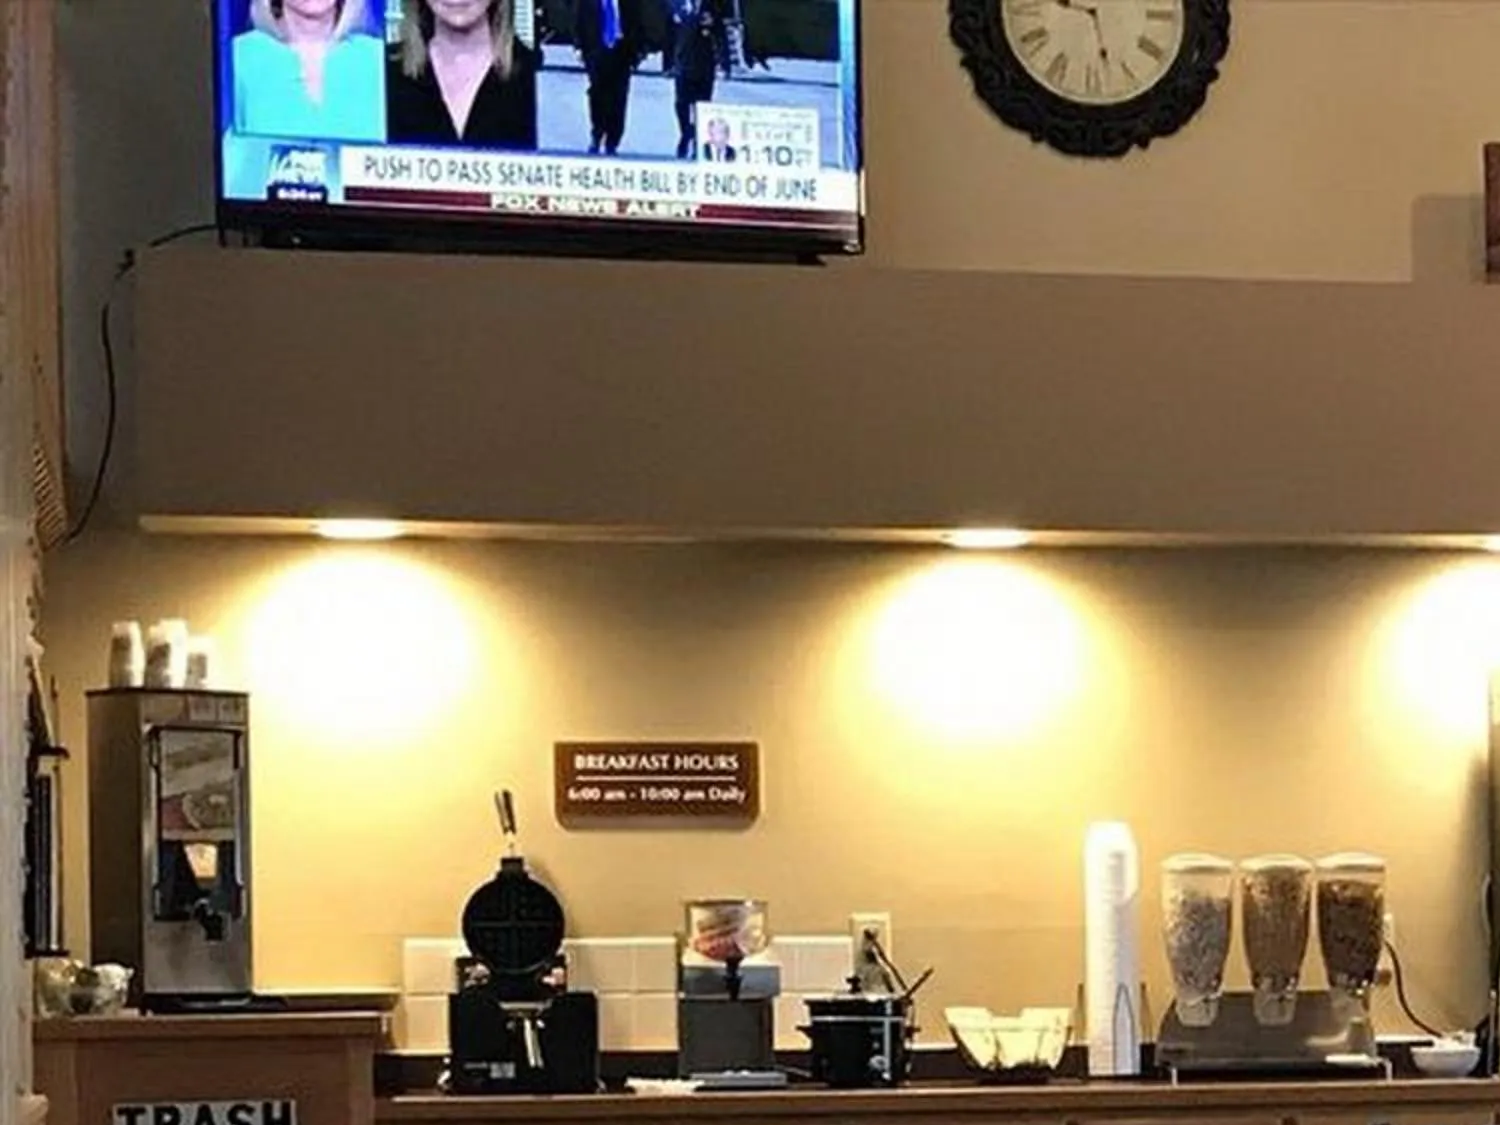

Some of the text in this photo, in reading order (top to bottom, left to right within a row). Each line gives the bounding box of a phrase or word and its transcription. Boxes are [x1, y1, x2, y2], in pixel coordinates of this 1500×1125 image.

[364, 155, 818, 201] PUSH TO PASS SENATE HEALTH BILL BY END OF JUNE
[491, 193, 702, 218] FOX NEWS ALERT
[574, 754, 739, 771] BREAKFAST HOURS
[567, 786, 601, 801] 6:00
[603, 788, 627, 800] am
[639, 786, 681, 801] 10:00
[683, 788, 706, 800] am
[707, 785, 747, 804] Daily
